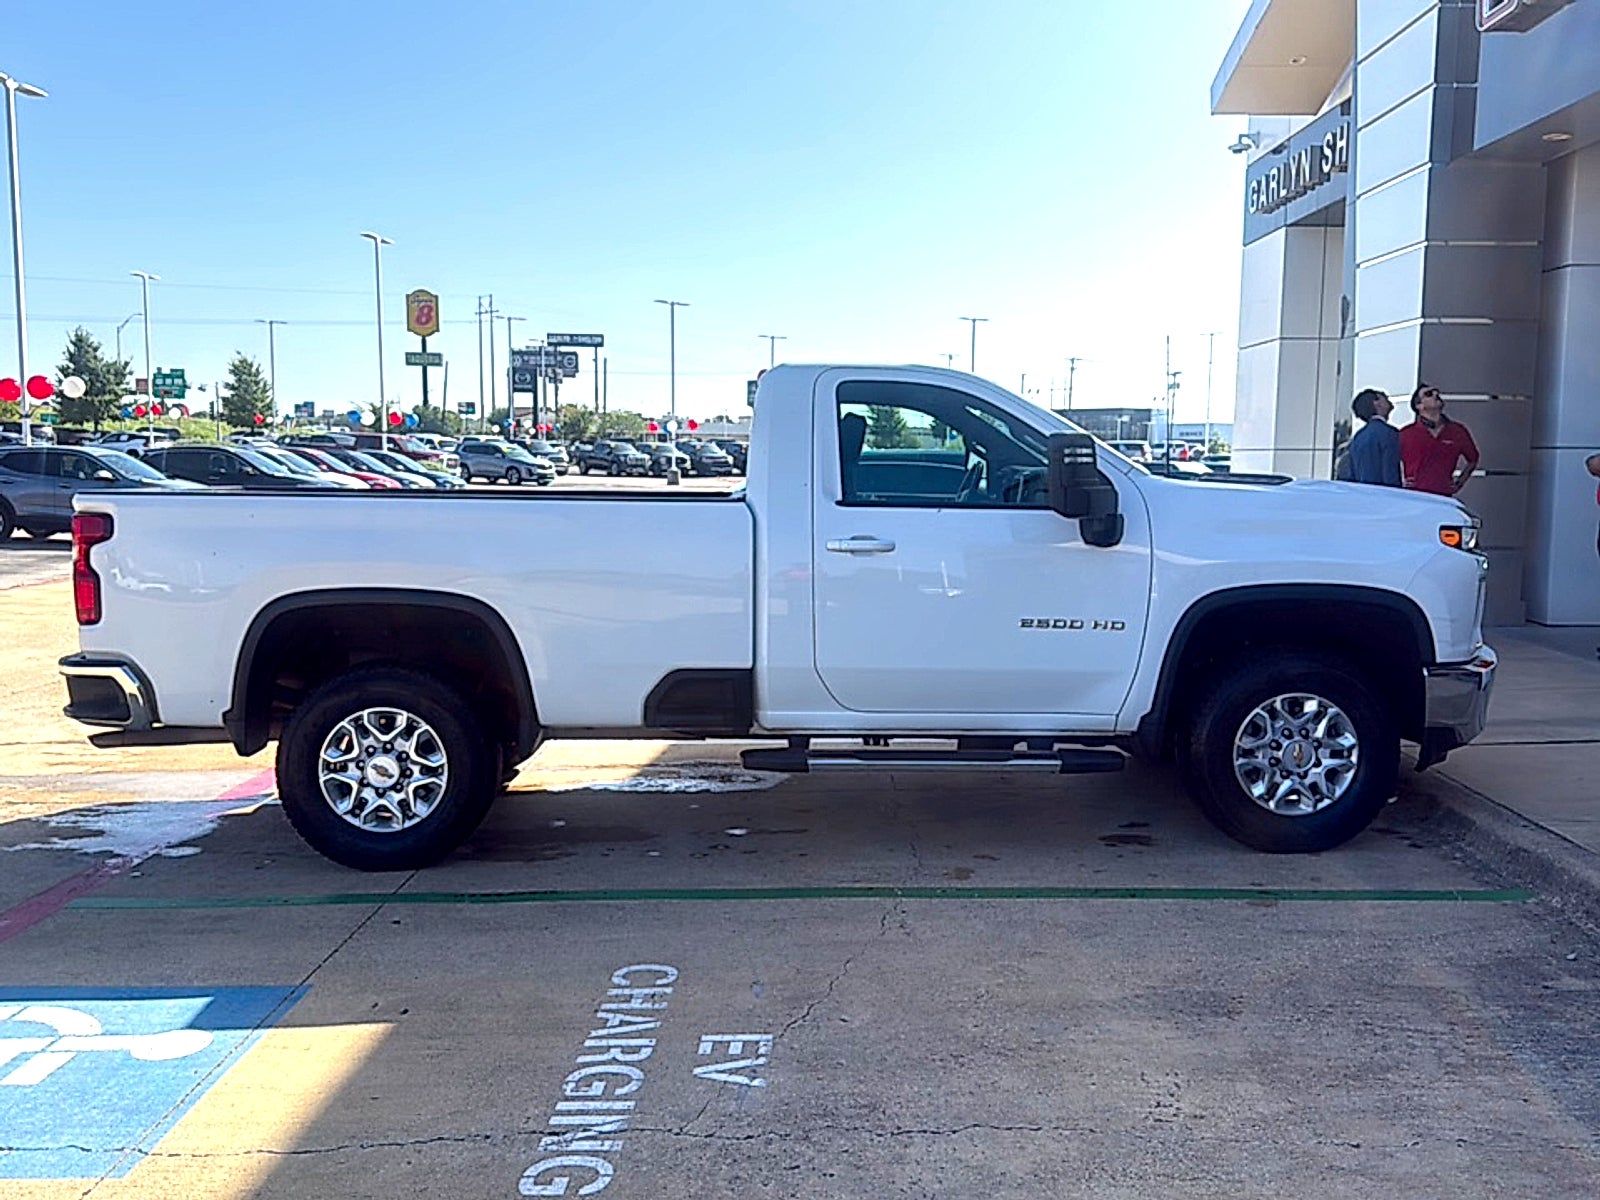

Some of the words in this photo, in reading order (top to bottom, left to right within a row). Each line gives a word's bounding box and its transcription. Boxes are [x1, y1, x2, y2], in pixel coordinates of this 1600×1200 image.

[1249, 146, 1312, 214] GARLYN
[1321, 122, 1349, 174] SH
[414, 303, 434, 326] 8
[1020, 618, 1084, 630] 2500
[1092, 619, 1126, 631] HD
[518, 963, 679, 1197] CHARGING
[692, 1033, 774, 1088] EV
